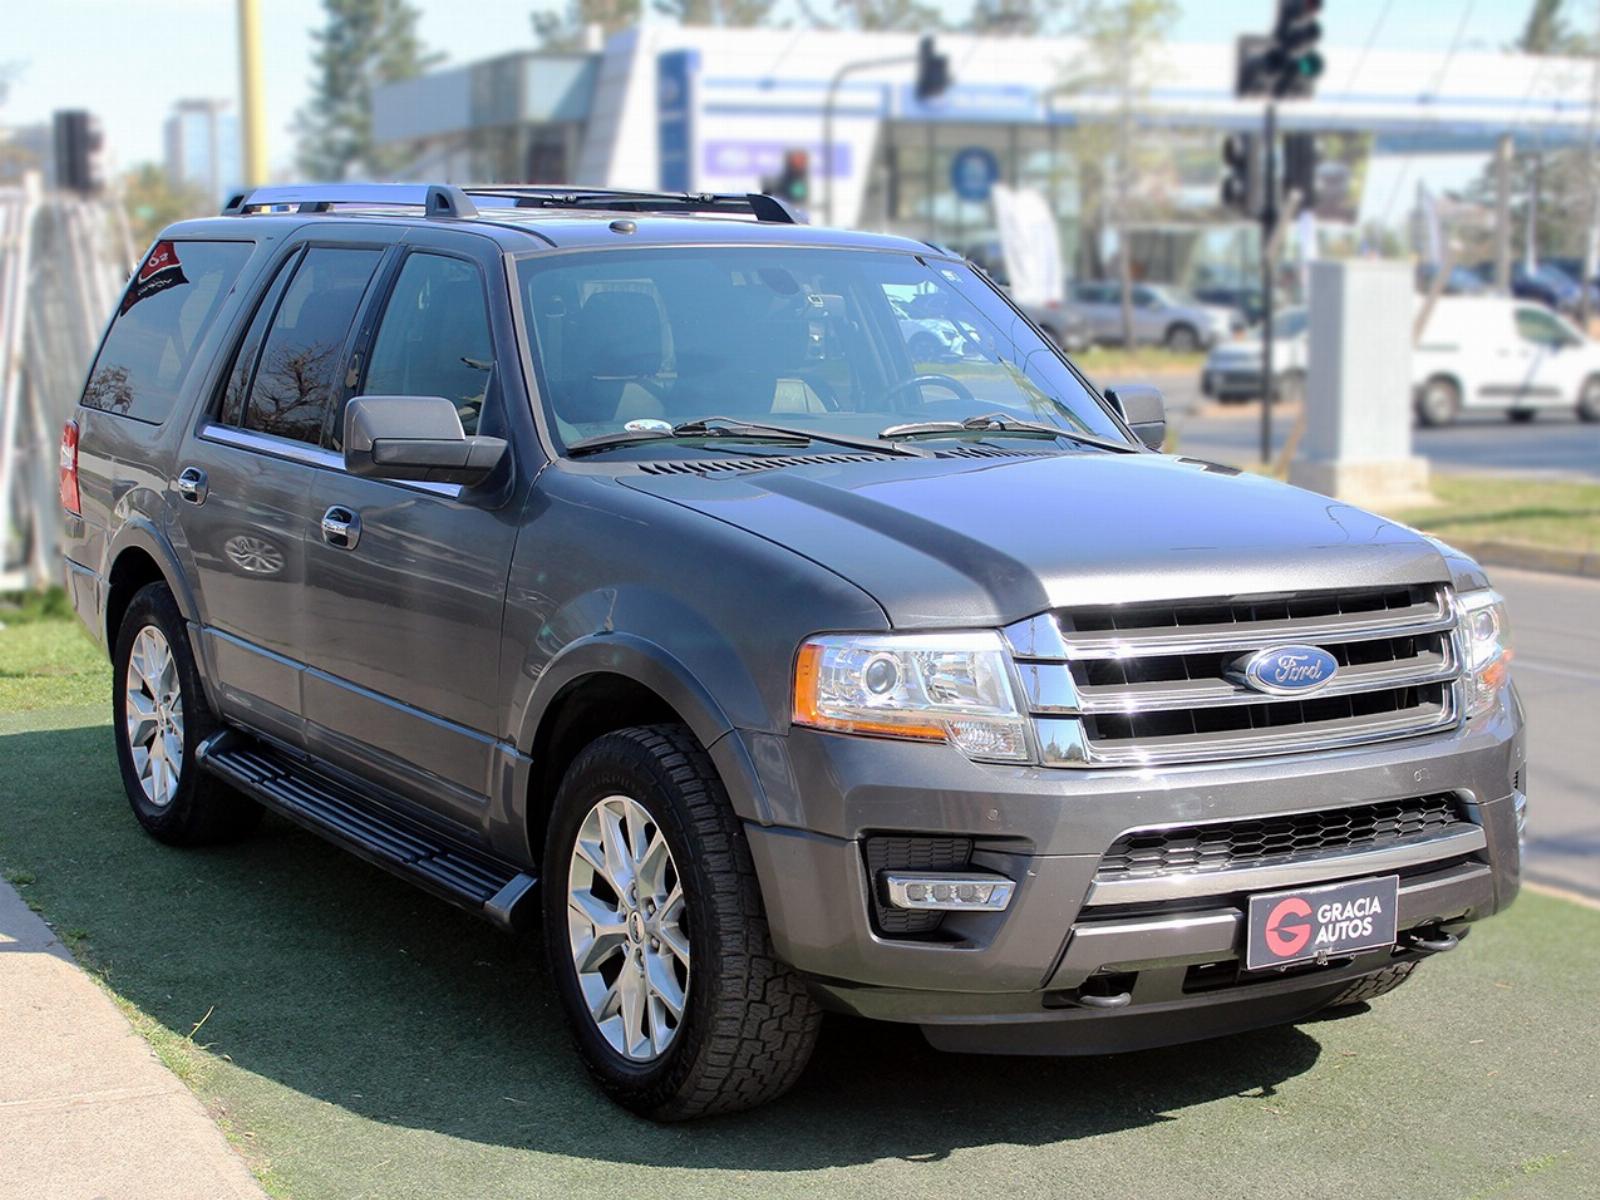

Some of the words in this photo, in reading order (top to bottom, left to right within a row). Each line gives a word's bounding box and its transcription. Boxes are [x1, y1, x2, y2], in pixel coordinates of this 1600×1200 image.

[1275, 655, 1323, 682] Ford
[1317, 896, 1382, 924] GRACIA
[1315, 917, 1373, 945] AUTOS
